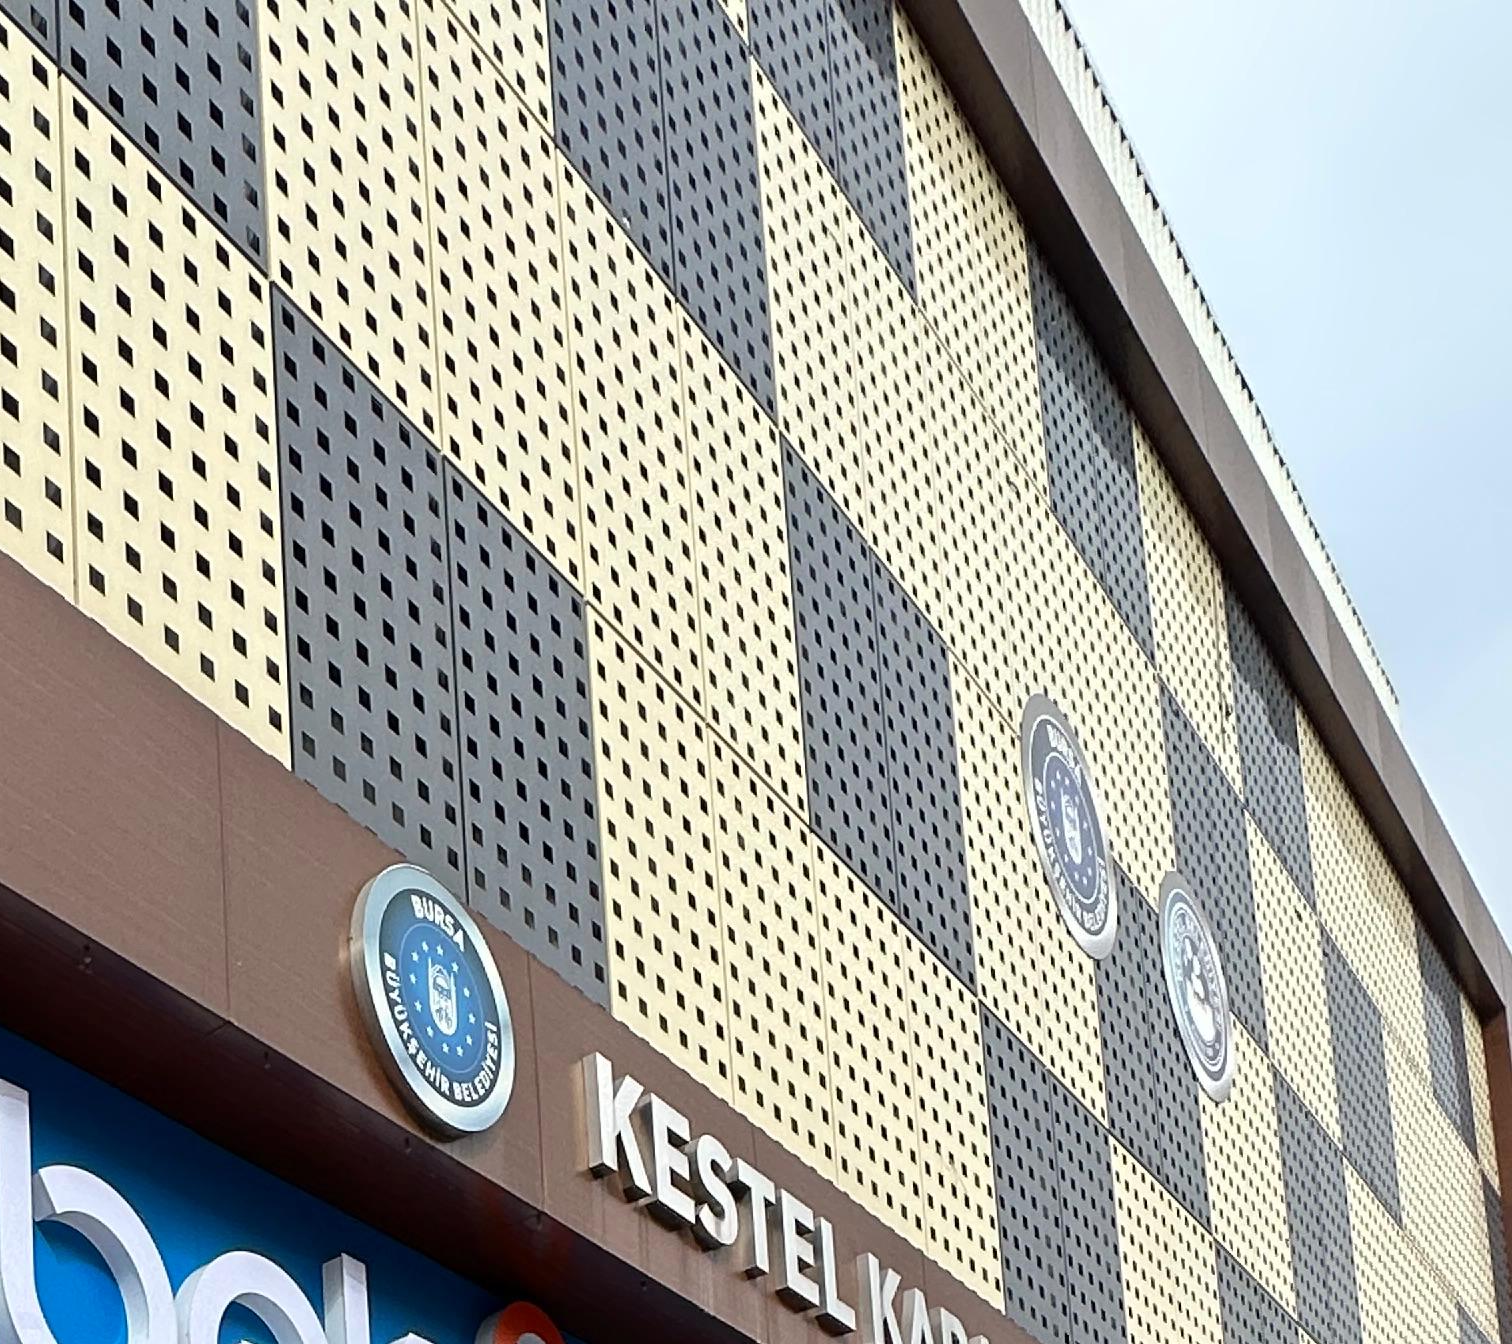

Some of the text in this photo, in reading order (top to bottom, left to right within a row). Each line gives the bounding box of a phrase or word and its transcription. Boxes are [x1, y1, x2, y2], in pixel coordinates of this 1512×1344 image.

[410, 894, 466, 952] BURSA
[383, 952, 452, 1096] BÜYÜKŞEHİR
[582, 1051, 856, 1335] KESTEL
